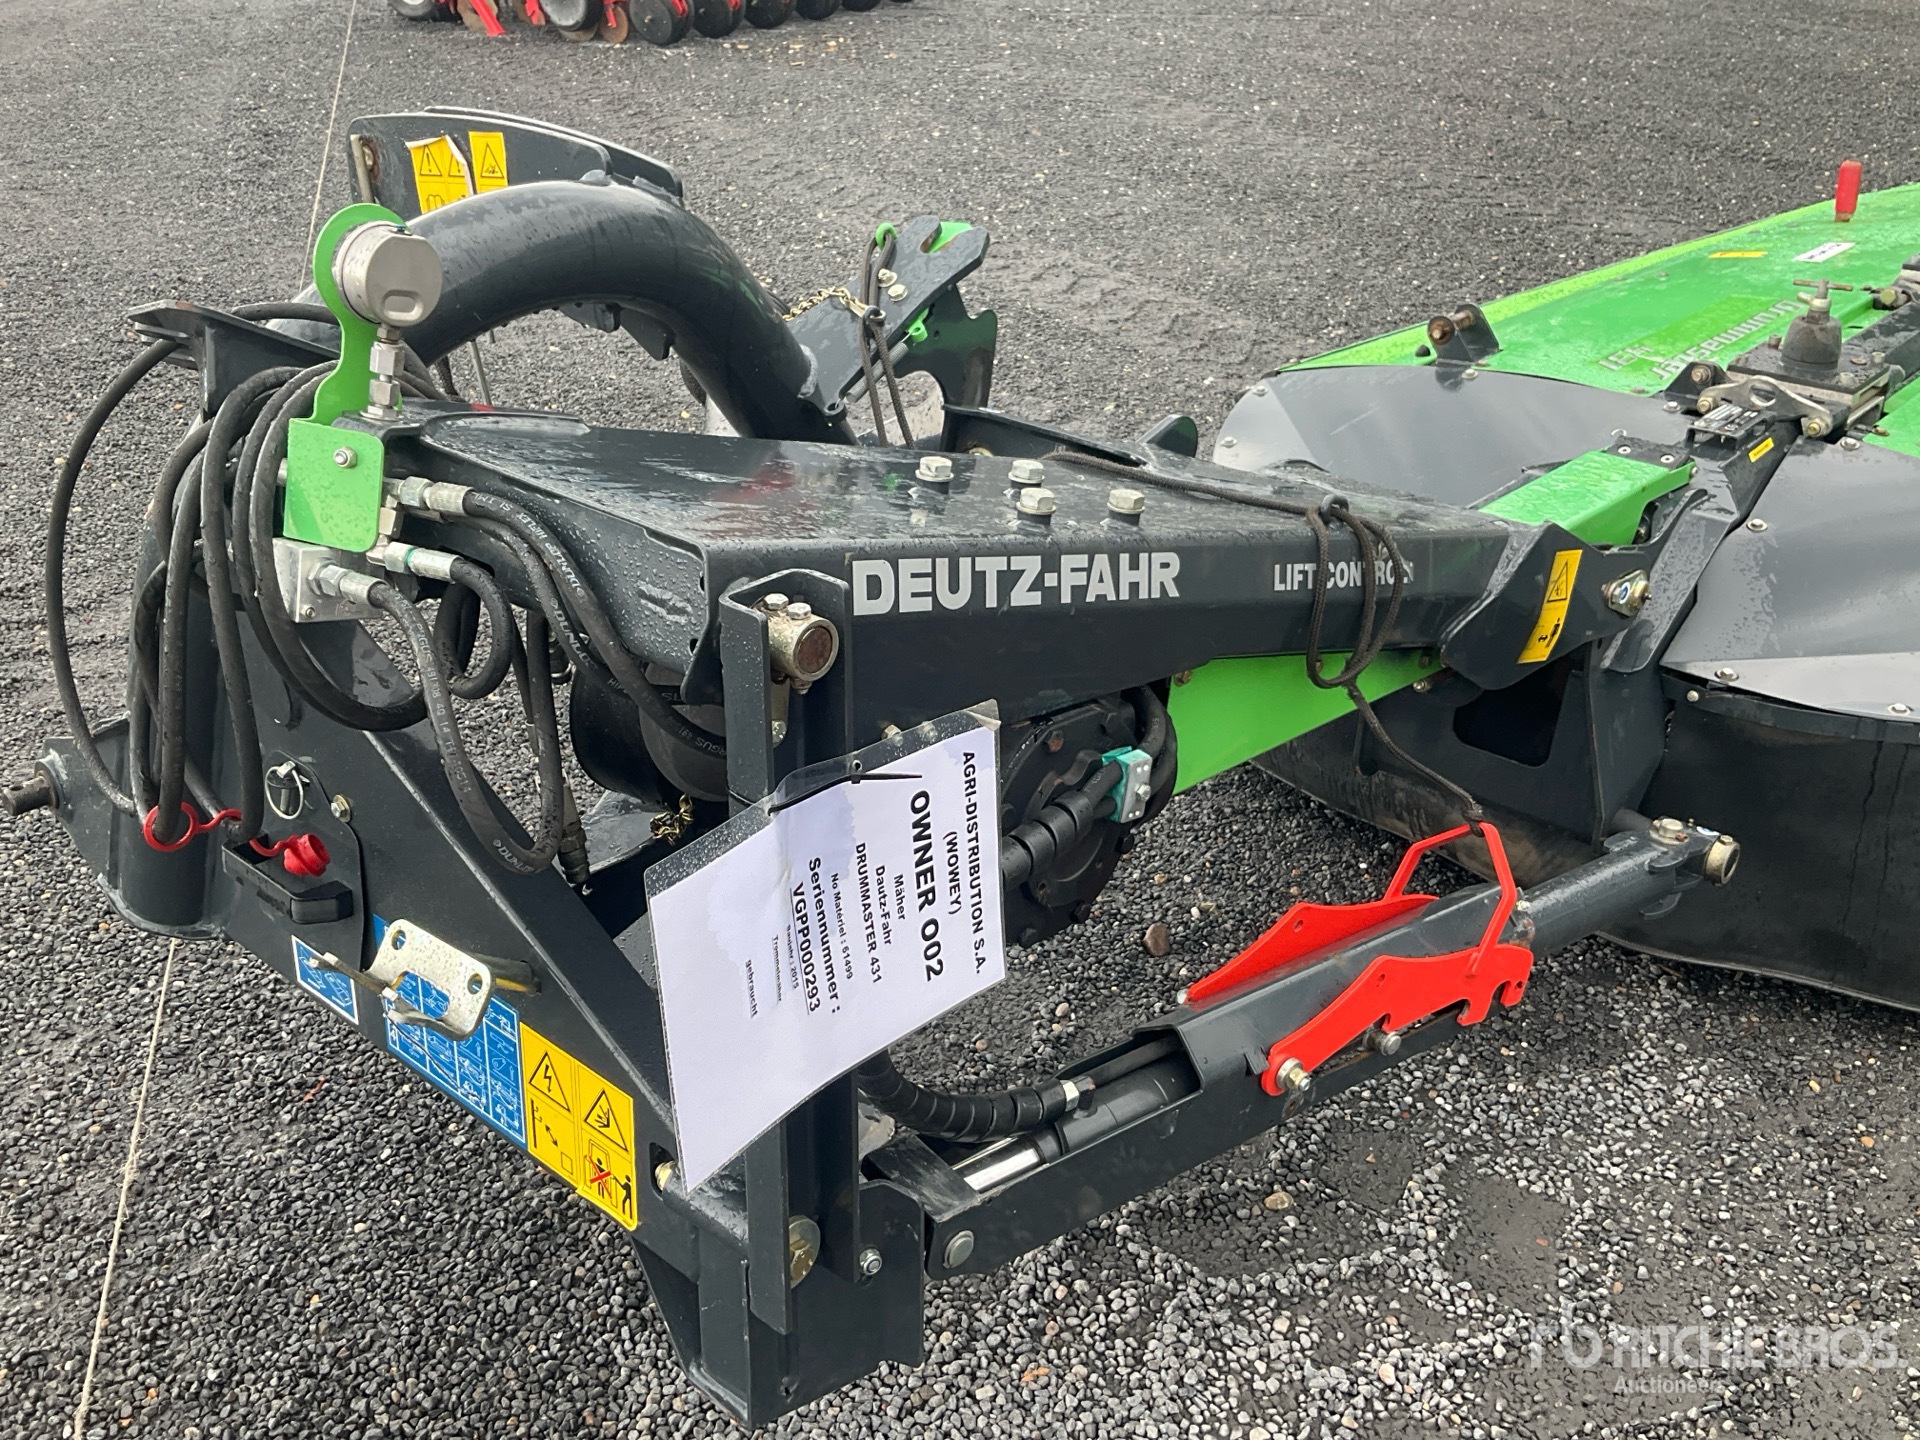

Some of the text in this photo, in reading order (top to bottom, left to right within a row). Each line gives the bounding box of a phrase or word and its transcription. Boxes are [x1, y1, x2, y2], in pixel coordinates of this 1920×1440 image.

[545, 542, 581, 588] DUNLOP
[852, 551, 1181, 616] DEUTZ-FAHR
[1274, 560, 1409, 591] LIFT CONRO
[831, 873, 839, 890] No
[910, 790, 936, 913] OWNER
[943, 831, 961, 915] (WOWEY)
[963, 752, 986, 974] AGRI-DISTRIBUTION S.A.
[834, 891, 847, 938] Matériel
[856, 842, 882, 983] DRUMMASTER 431
[875, 865, 892, 945] Dautz-Fahr
[894, 873, 905, 920] Mäher
[793, 882, 821, 1012] VGPP000293
[809, 857, 839, 1001] Seriennummer
[745, 959, 759, 1018] gebraucht
[790, 965, 800, 989] 2015
[842, 945, 854, 980] 61499
